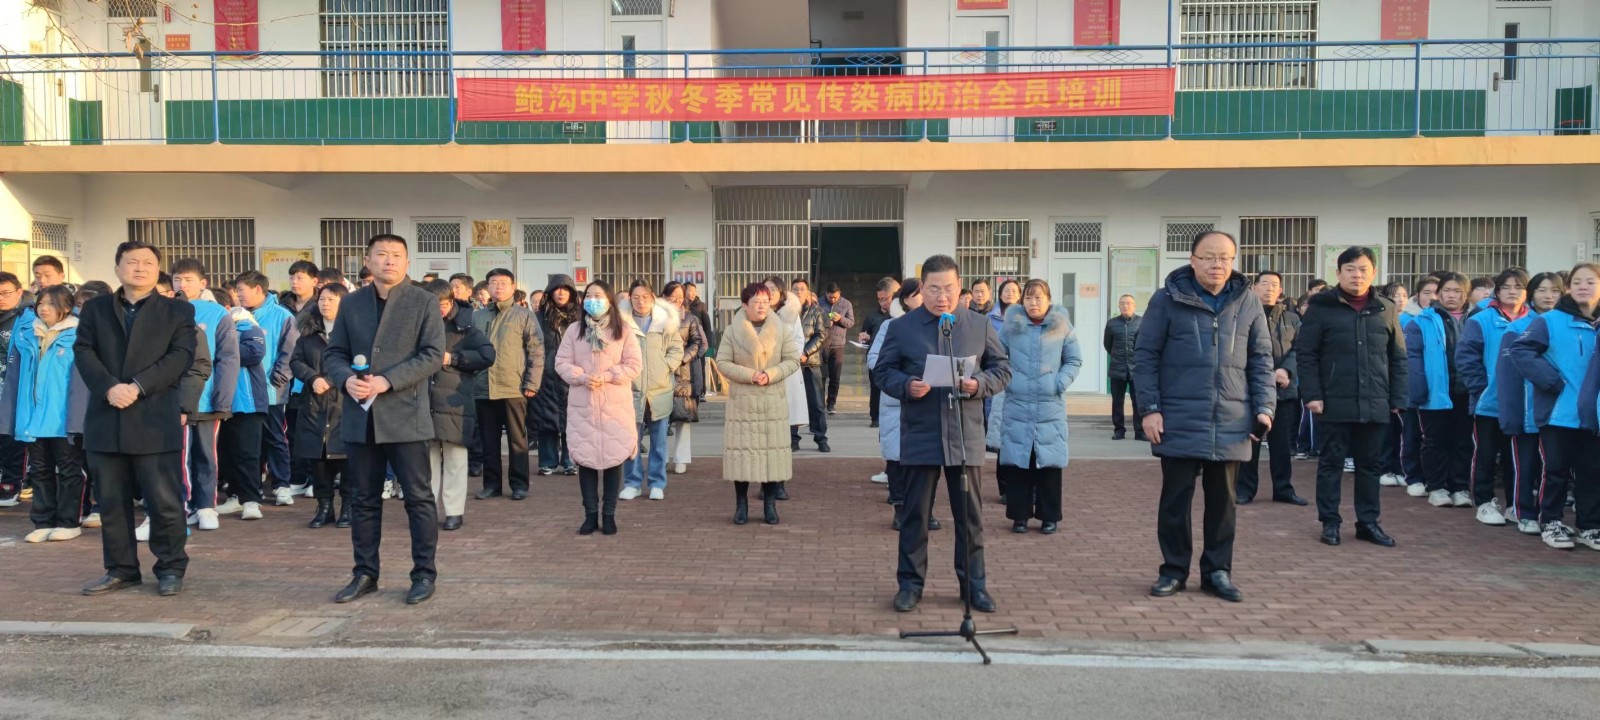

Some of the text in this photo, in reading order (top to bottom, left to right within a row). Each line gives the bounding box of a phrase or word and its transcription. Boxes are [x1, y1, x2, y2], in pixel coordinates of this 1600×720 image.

[514, 77, 1122, 114] 鲍沟中学秋冬季常见传染病防治全员培训
